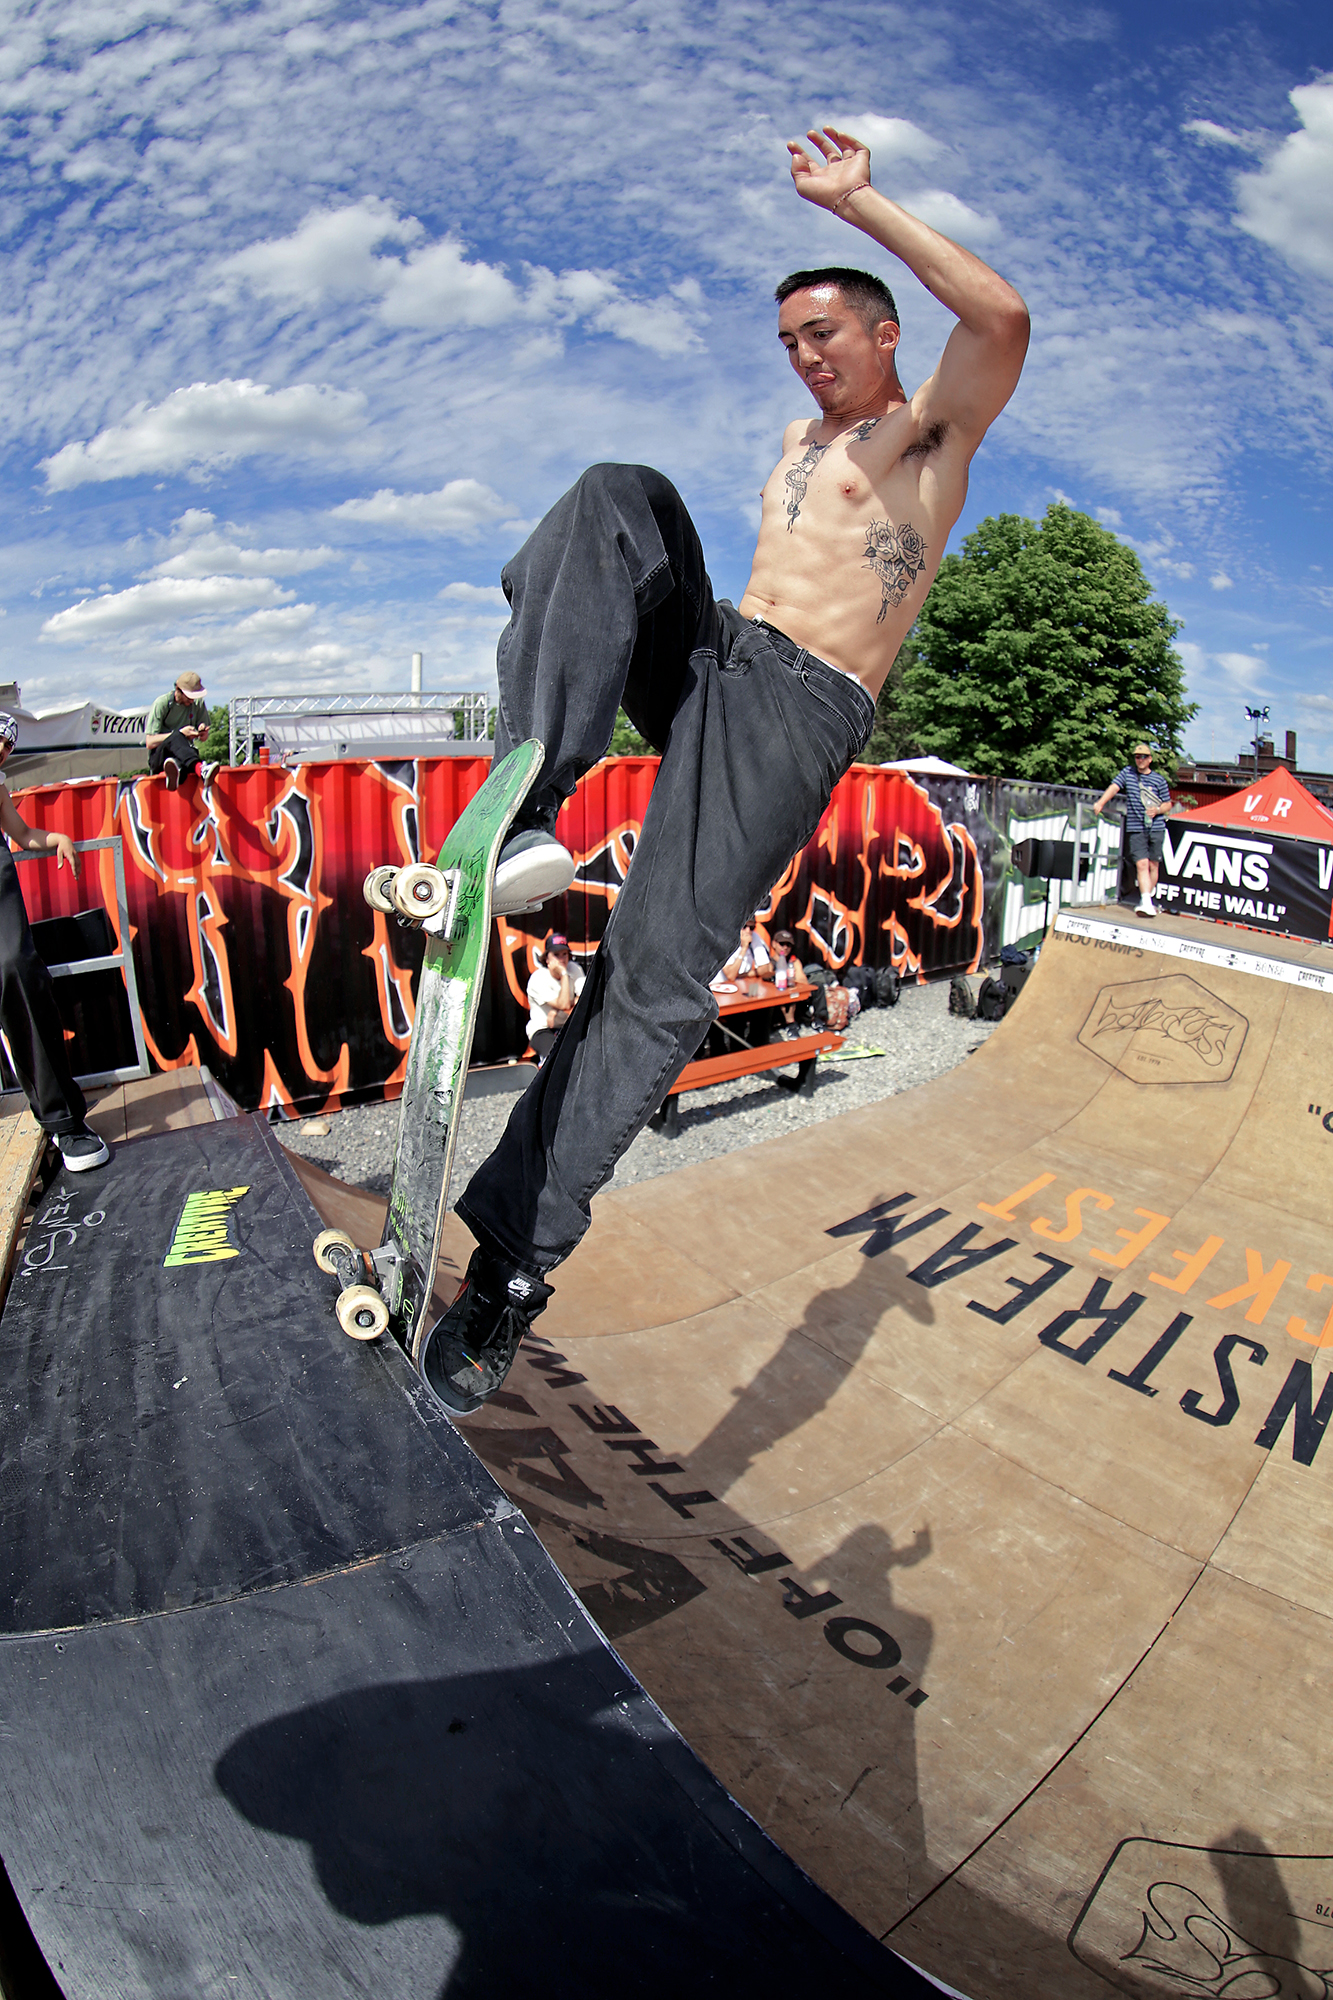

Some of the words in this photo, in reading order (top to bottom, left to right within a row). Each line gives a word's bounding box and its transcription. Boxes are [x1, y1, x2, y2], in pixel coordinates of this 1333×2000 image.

[1162, 828, 1274, 892] VANS
[1183, 887, 1222, 911] THE
[1224, 894, 1287, 922] WALL"
[568, 1404, 720, 1519] THE
